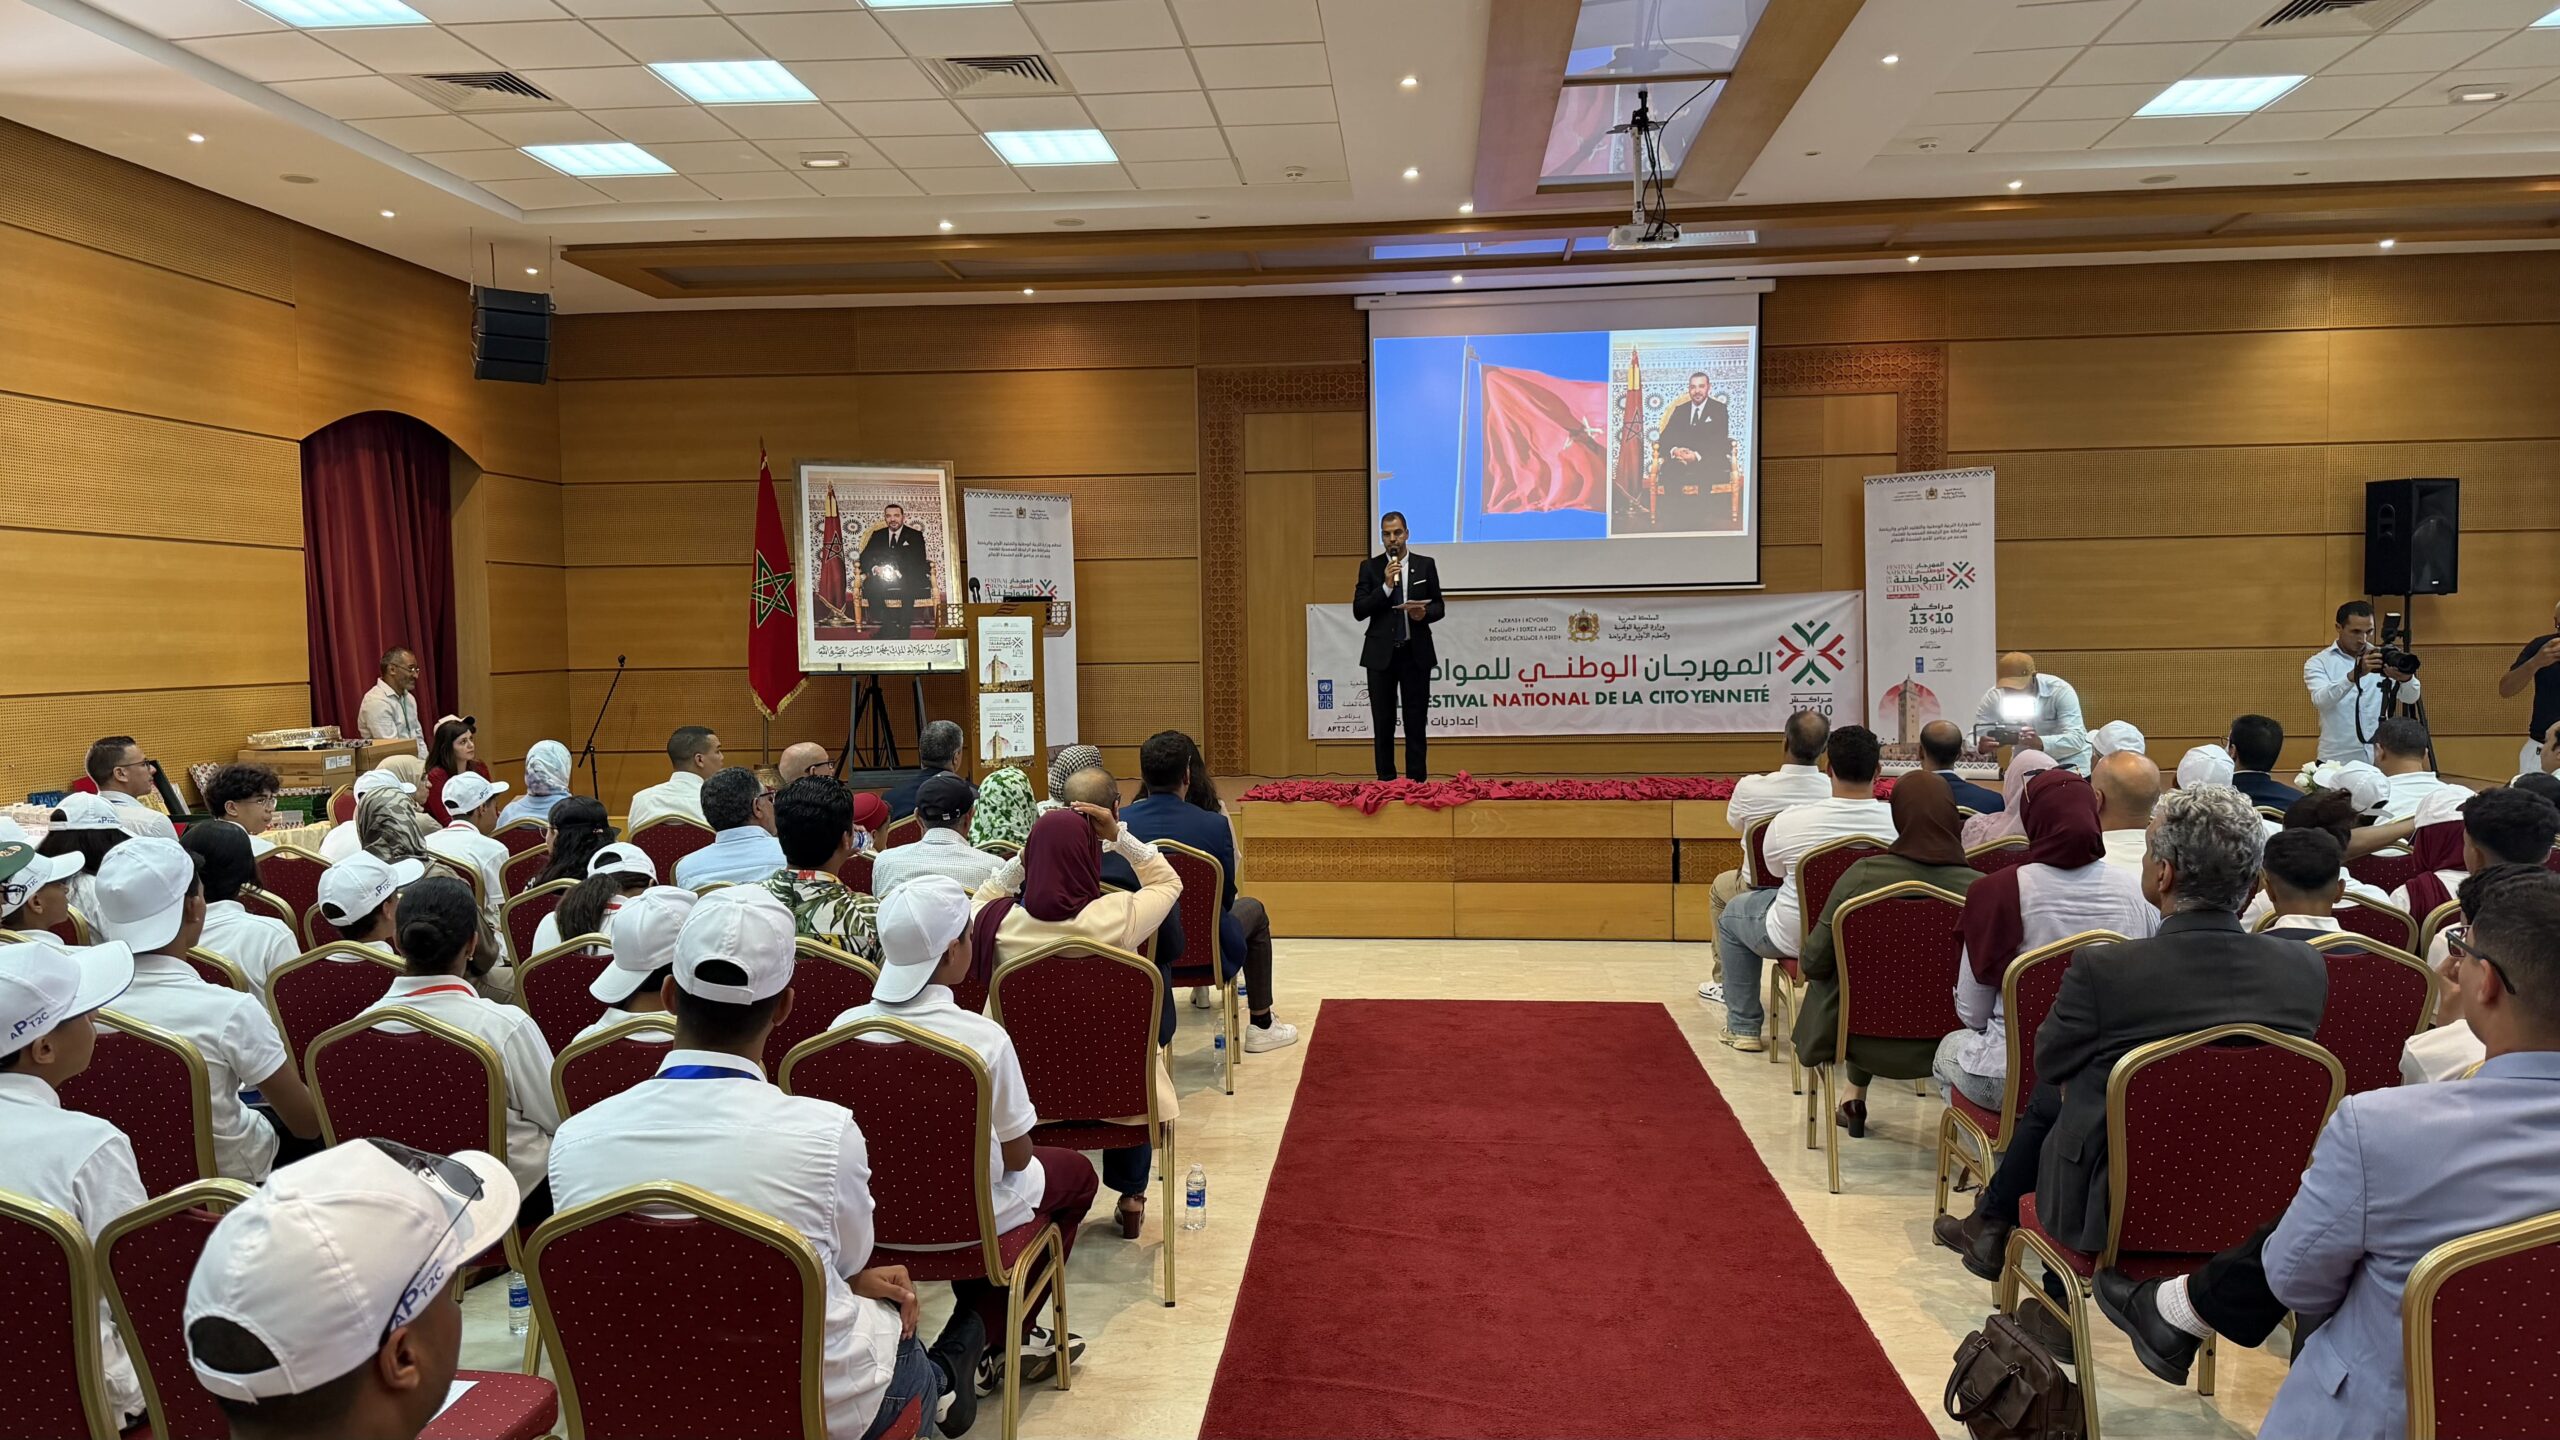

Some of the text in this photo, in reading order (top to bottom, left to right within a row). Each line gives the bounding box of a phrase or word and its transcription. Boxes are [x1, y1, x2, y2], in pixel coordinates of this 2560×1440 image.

[1893, 574, 1945, 584] للمواطنة
[1909, 603, 1953, 612] مراكش
[1909, 626, 1953, 635] يونيو 2026
[1518, 654, 1637, 689] الوطني
[1644, 651, 1772, 682] المهرجان
[1493, 692, 1589, 707] NATIONAL
[1595, 691, 1617, 705] DE
[1622, 690, 1643, 705] LA
[1649, 684, 1770, 705] CITOYENNETÉ
[1789, 696, 1832, 704] مراكش
[1431, 715, 1478, 728] إعداديات
